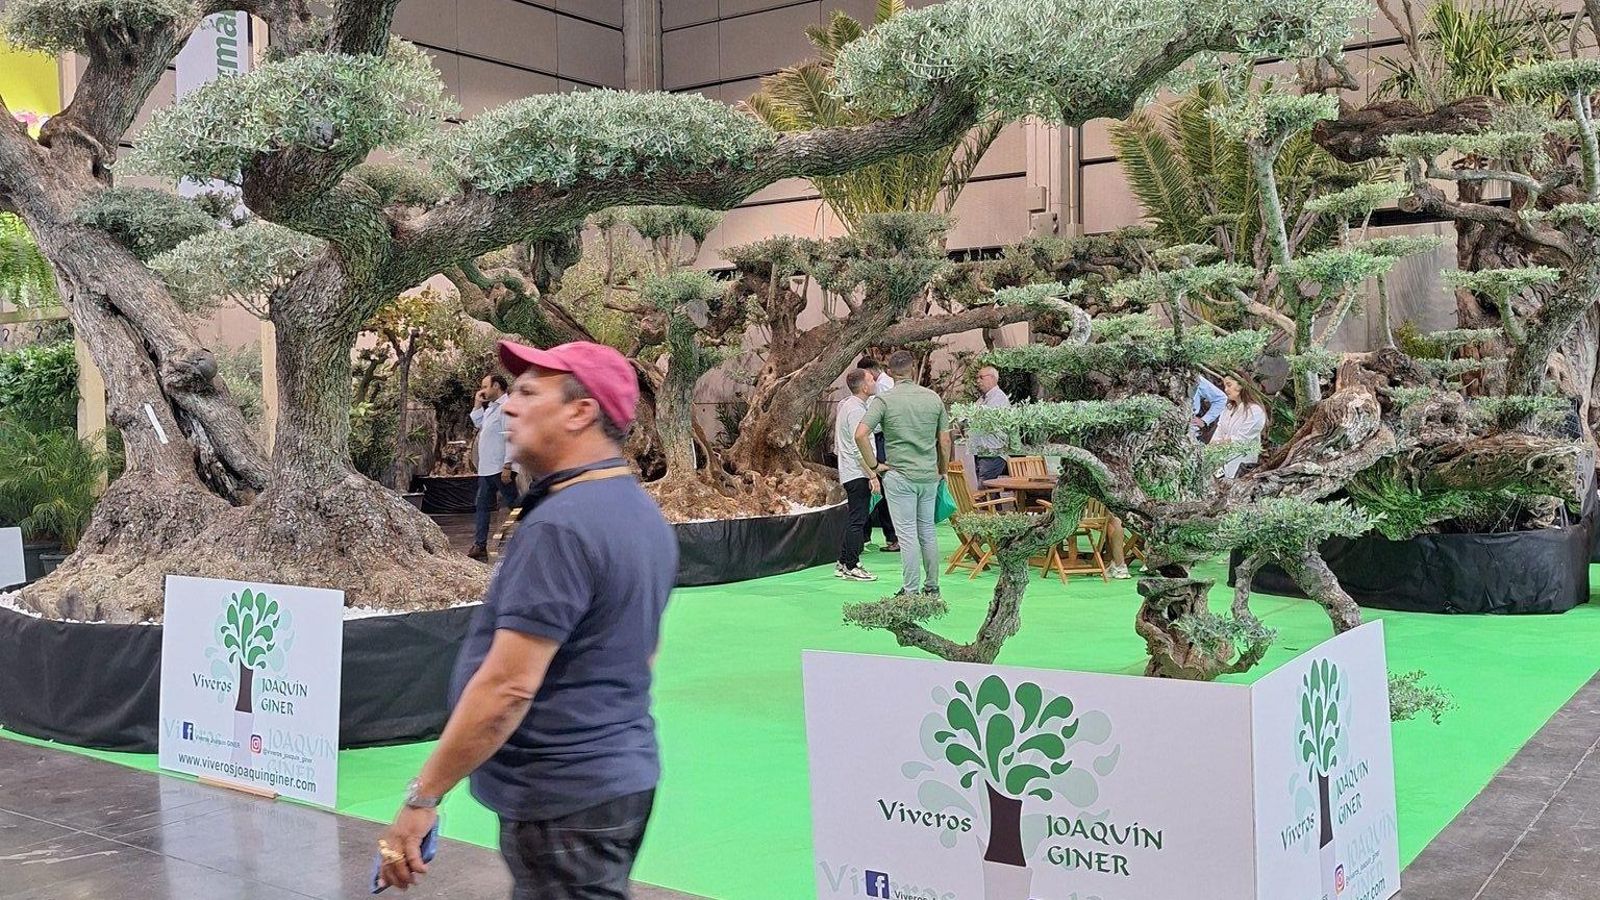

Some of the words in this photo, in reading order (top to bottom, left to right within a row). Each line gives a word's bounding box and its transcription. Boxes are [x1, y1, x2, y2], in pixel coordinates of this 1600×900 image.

[193, 673, 232, 693] Viveros
[262, 678, 308, 697] JOAQUÍN
[261, 698, 294, 715] GINER
[178, 753, 316, 792] www.viverosjoaquinginer.com
[877, 799, 972, 832] Viveros
[1338, 793, 1362, 824] GINER
[1046, 815, 1162, 850] JOAQUÍN
[1281, 813, 1315, 851] Viveros
[1047, 846, 1130, 876] GINER
